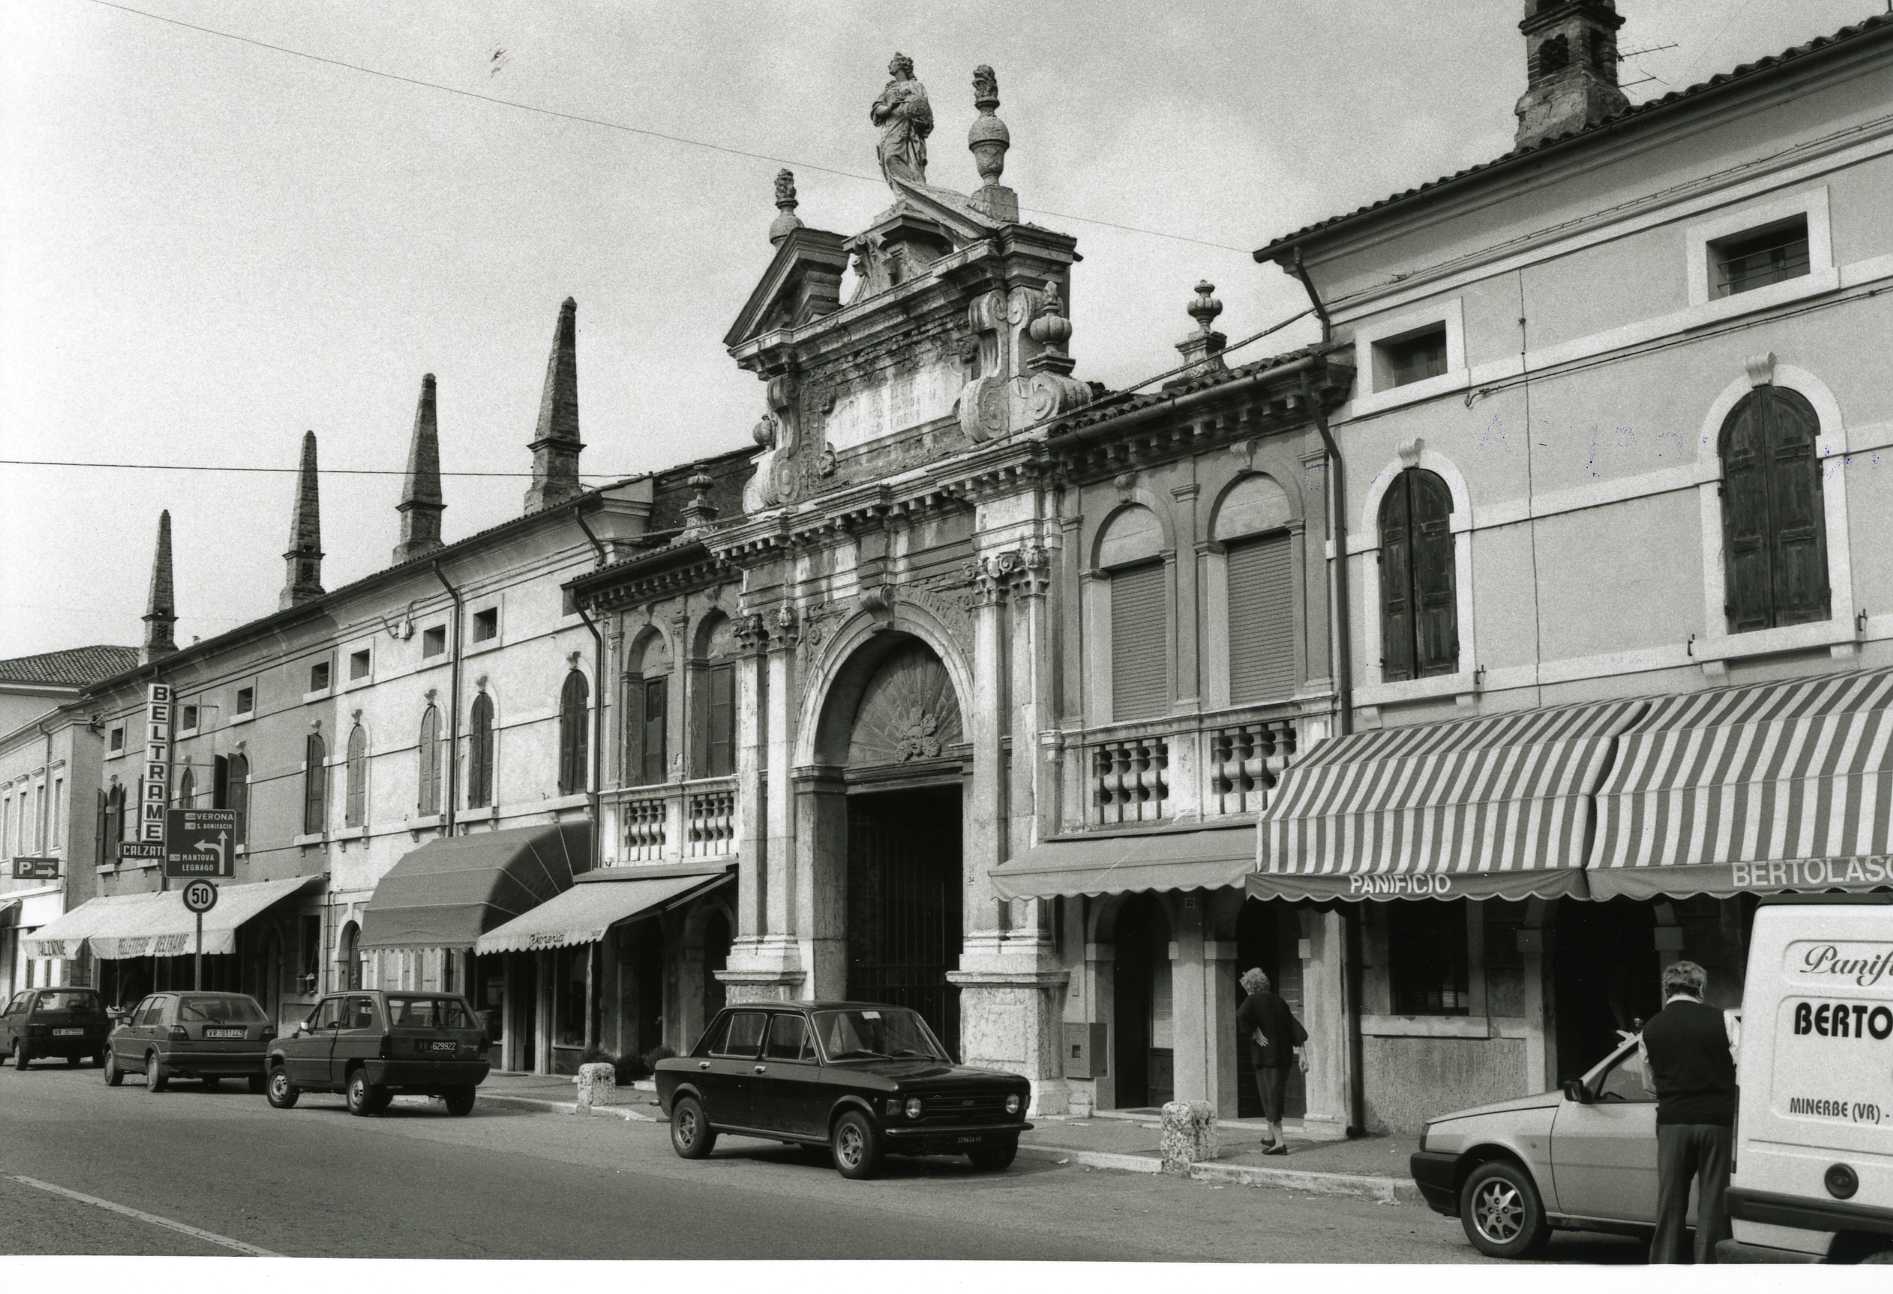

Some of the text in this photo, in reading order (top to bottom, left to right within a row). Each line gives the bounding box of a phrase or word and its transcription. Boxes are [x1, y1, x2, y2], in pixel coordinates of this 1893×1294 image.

[145, 686, 168, 839] BELTRAME
[196, 813, 234, 821] VERONA
[19, 862, 32, 875] P
[191, 888, 209, 904] 50
[1350, 874, 1451, 894] PANIFICIO
[1799, 944, 1893, 987] Panif
[1794, 1002, 1893, 1040] BERTO
[1790, 1097, 1848, 1118] MINERBE
[1852, 1102, 1881, 1125] (VR)
